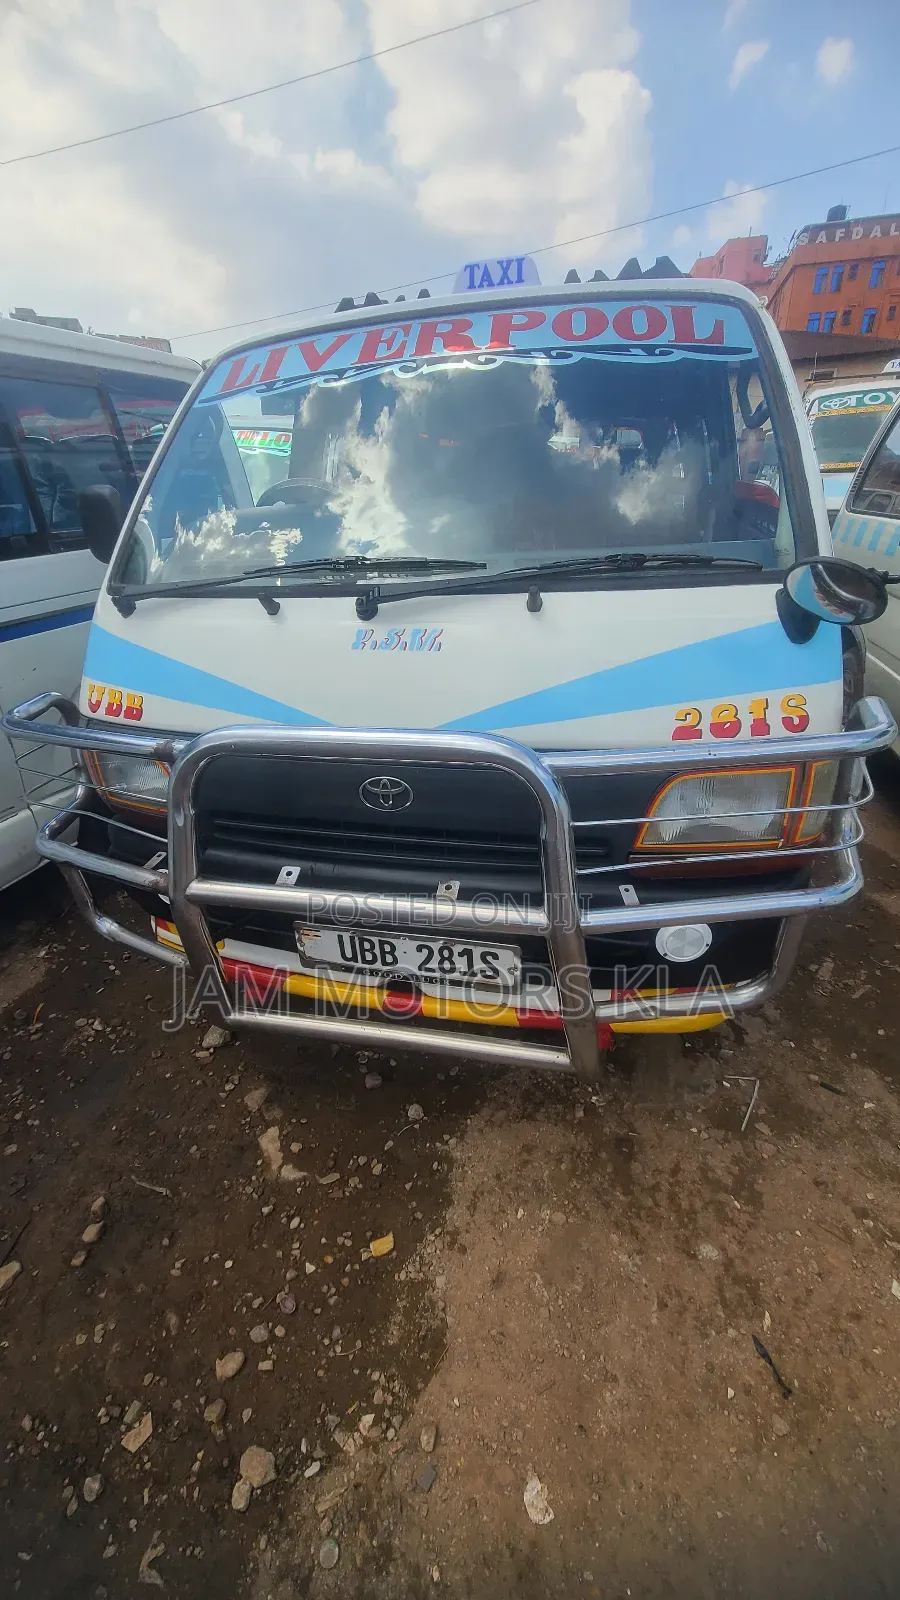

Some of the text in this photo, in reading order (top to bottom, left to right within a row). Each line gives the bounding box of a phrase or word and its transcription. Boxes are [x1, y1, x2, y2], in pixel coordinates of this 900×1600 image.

[799, 222, 900, 246] SAFDAL
[464, 257, 526, 290] TAXI
[215, 305, 725, 394] LIVERPOOL
[87, 683, 143, 721] UBB
[671, 693, 810, 741] 281S
[337, 933, 500, 979] UBB 281S
